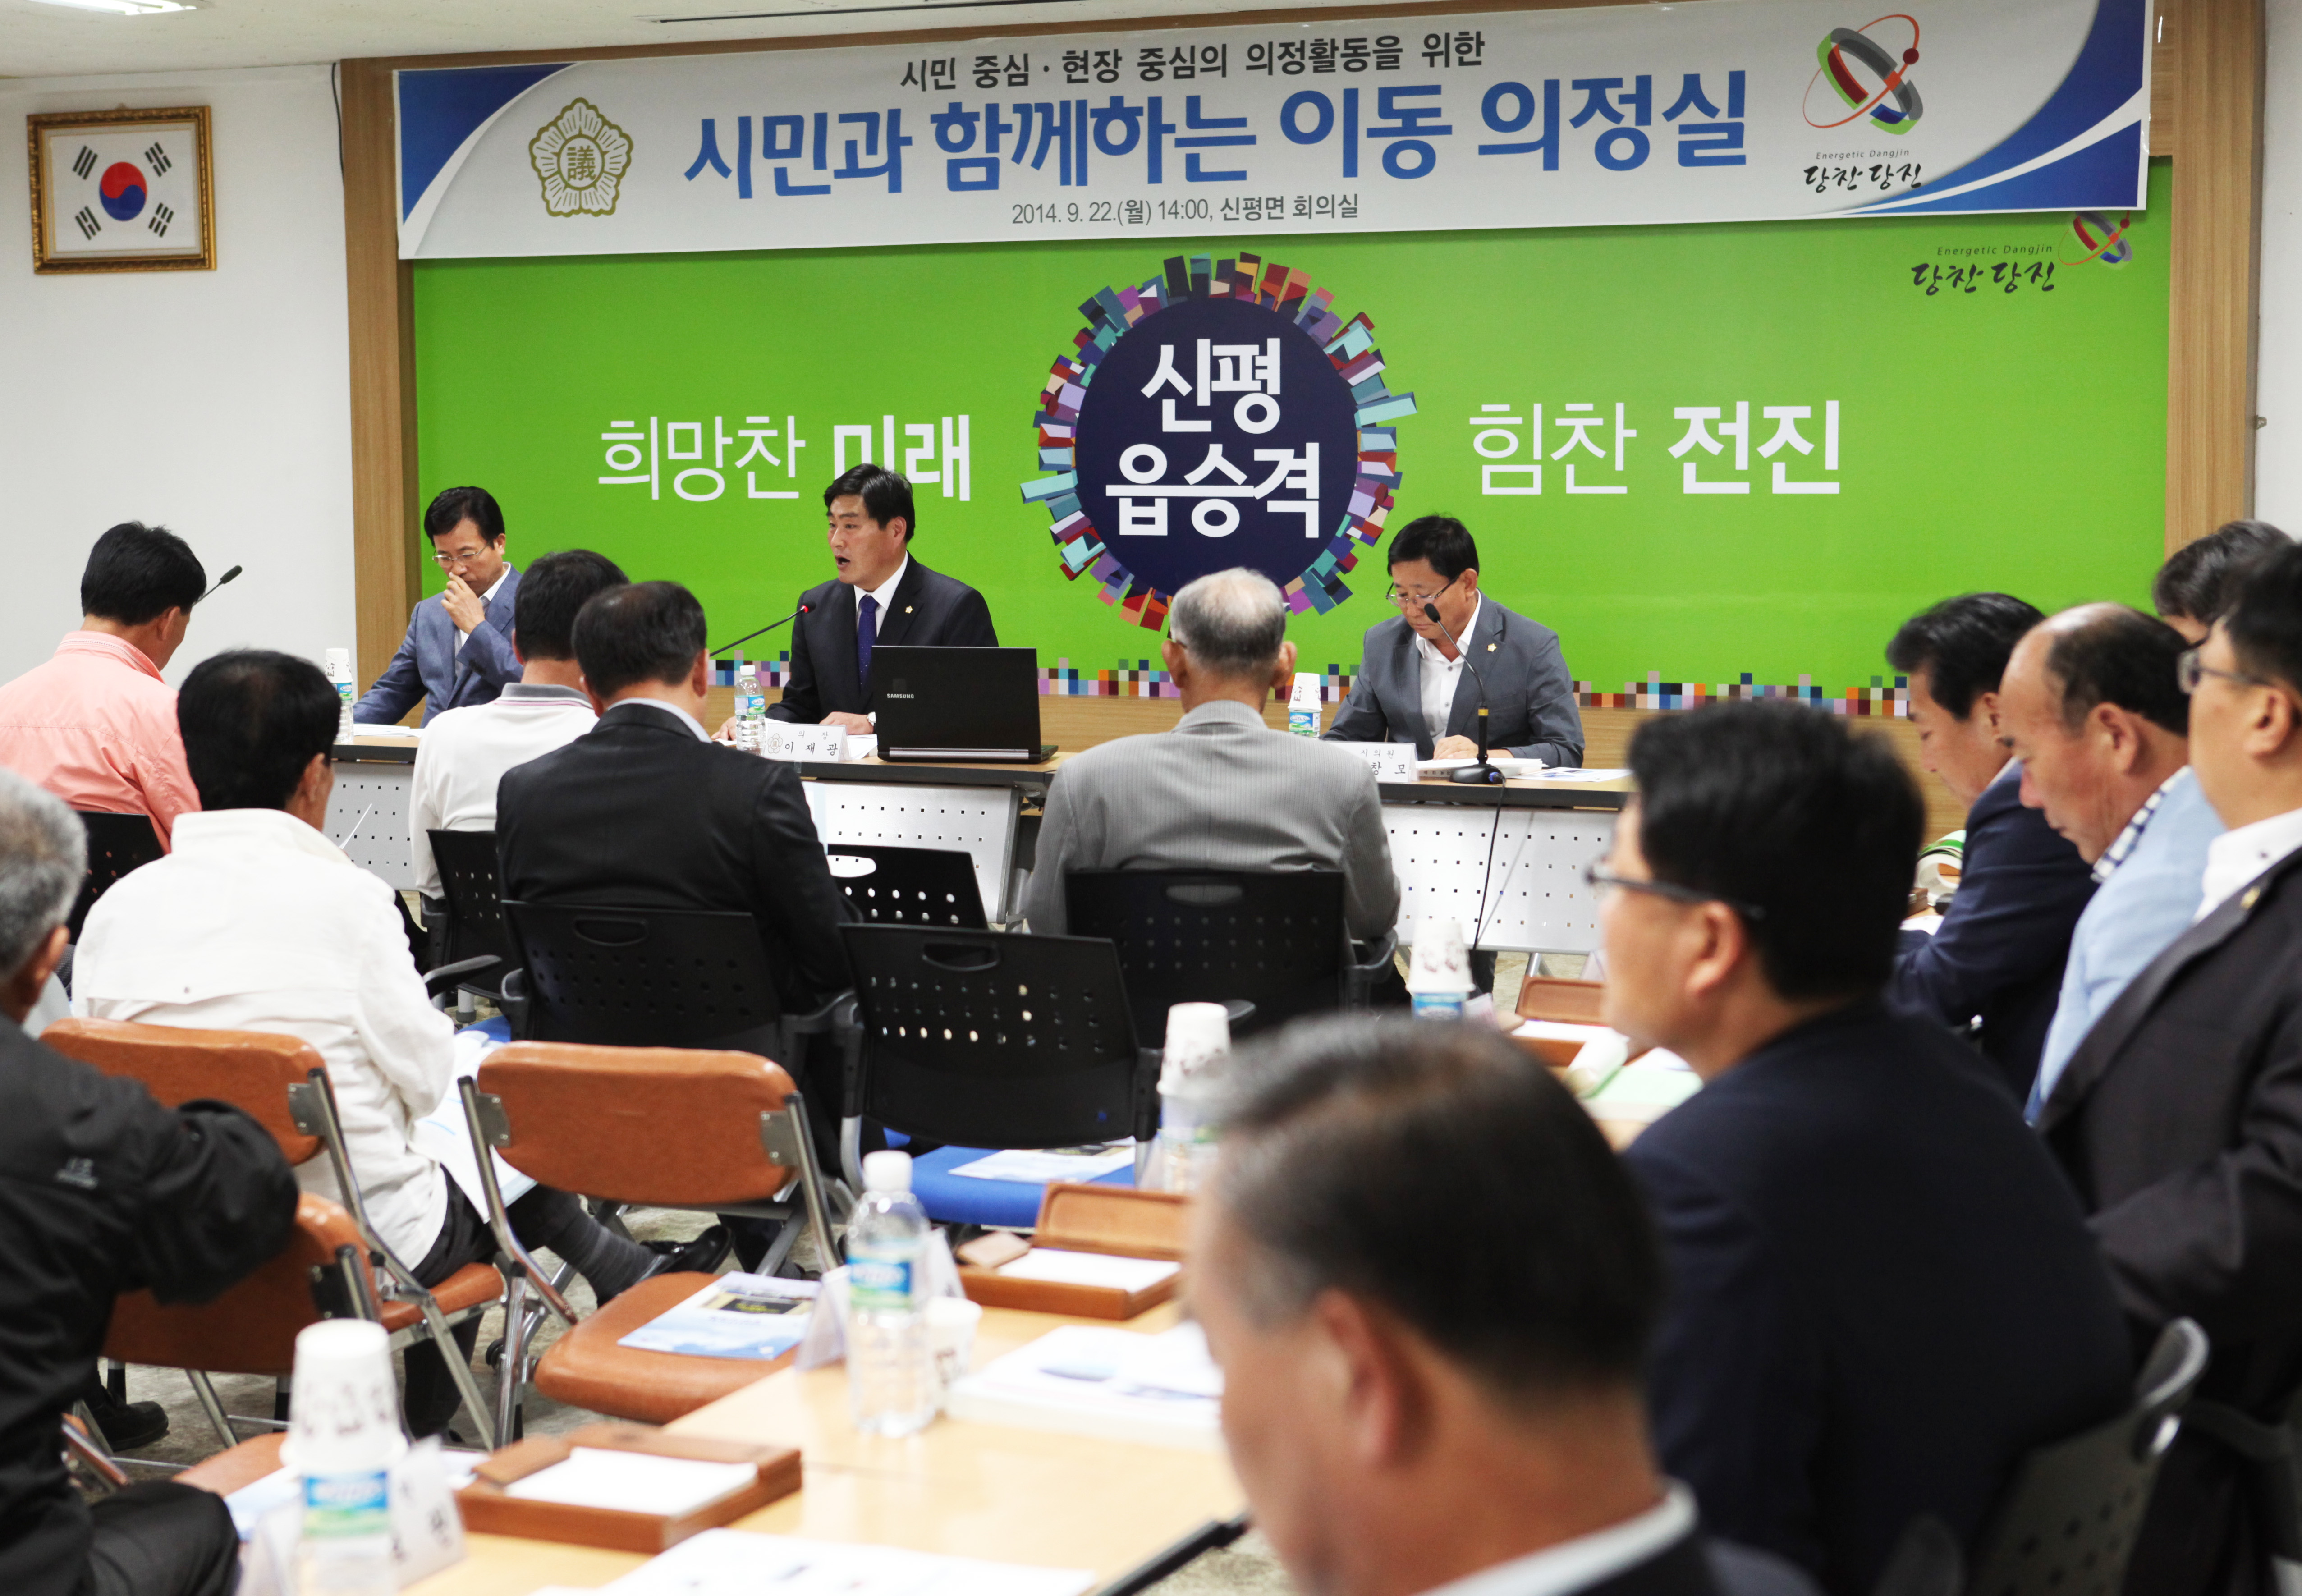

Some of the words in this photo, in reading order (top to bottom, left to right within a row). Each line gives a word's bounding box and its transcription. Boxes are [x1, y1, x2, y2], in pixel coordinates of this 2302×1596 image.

[900, 57, 956, 92] 시민
[973, 53, 1030, 89] 중심
[1062, 49, 1123, 84] 현장
[1137, 43, 1227, 82] 중심의
[1246, 35, 1404, 76] 의정활동을
[1422, 31, 1486, 68] 위한
[684, 109, 912, 199] 시민과
[931, 96, 1257, 193] 함께하는
[1280, 85, 1452, 179] 이동
[1478, 70, 1747, 171] 의정실
[1816, 151, 1865, 161] Energetic
[1870, 149, 1910, 158] Dangjin
[1803, 165, 1864, 193] 당찬
[1869, 163, 1922, 189] 당진
[1012, 203, 1062, 225] 2014.
[1158, 198, 1214, 222] 14:00,
[1220, 196, 1284, 222] 신평면
[1293, 194, 1358, 220] 회의실
[1911, 263, 1984, 296] 당찬
[1991, 261, 2055, 294] 당진
[1937, 246, 1997, 257] Energetic
[2003, 244, 2053, 256] Dangjin
[1141, 338, 1281, 434] 신평
[598, 415, 806, 502] 희망찬
[834, 415, 971, 501] 미래
[1469, 402, 1638, 495] 힘찬
[1667, 400, 1840, 495] 전진
[1105, 442, 1320, 538] 읍승격
